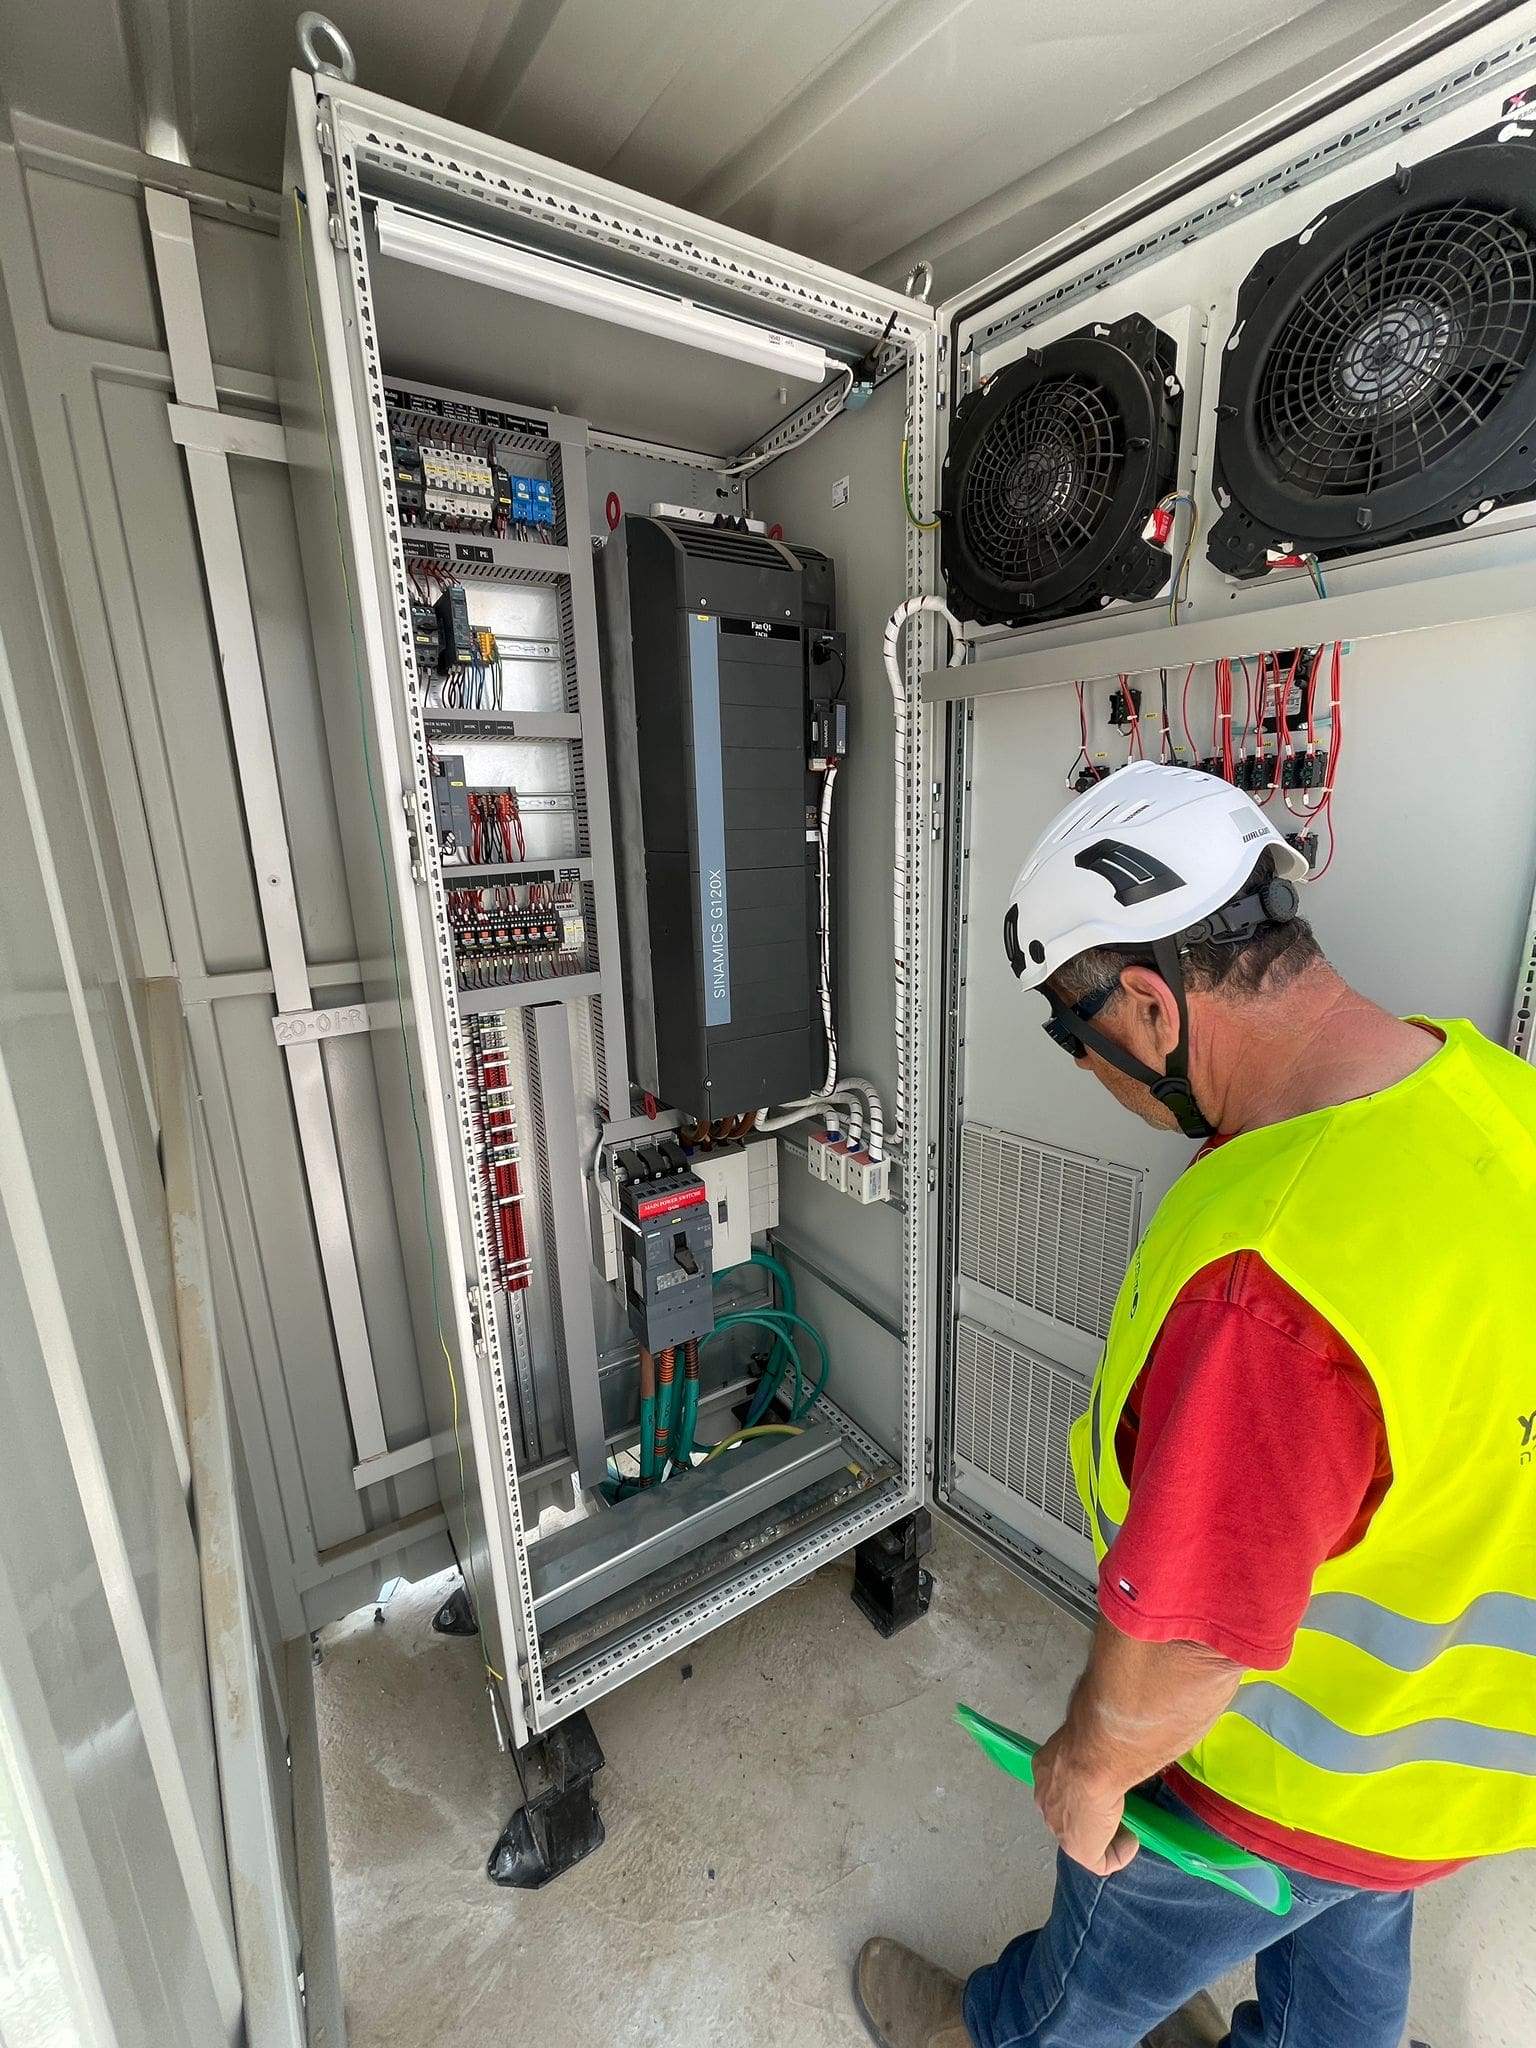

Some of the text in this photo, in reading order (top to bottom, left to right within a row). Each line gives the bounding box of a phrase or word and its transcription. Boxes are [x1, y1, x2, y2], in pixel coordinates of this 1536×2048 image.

[479, 550, 489, 559] PE
[751, 621, 762, 630] Fan
[709, 869, 725, 998] SINAMICS G120X
[660, 1197, 678, 1207] POWER
